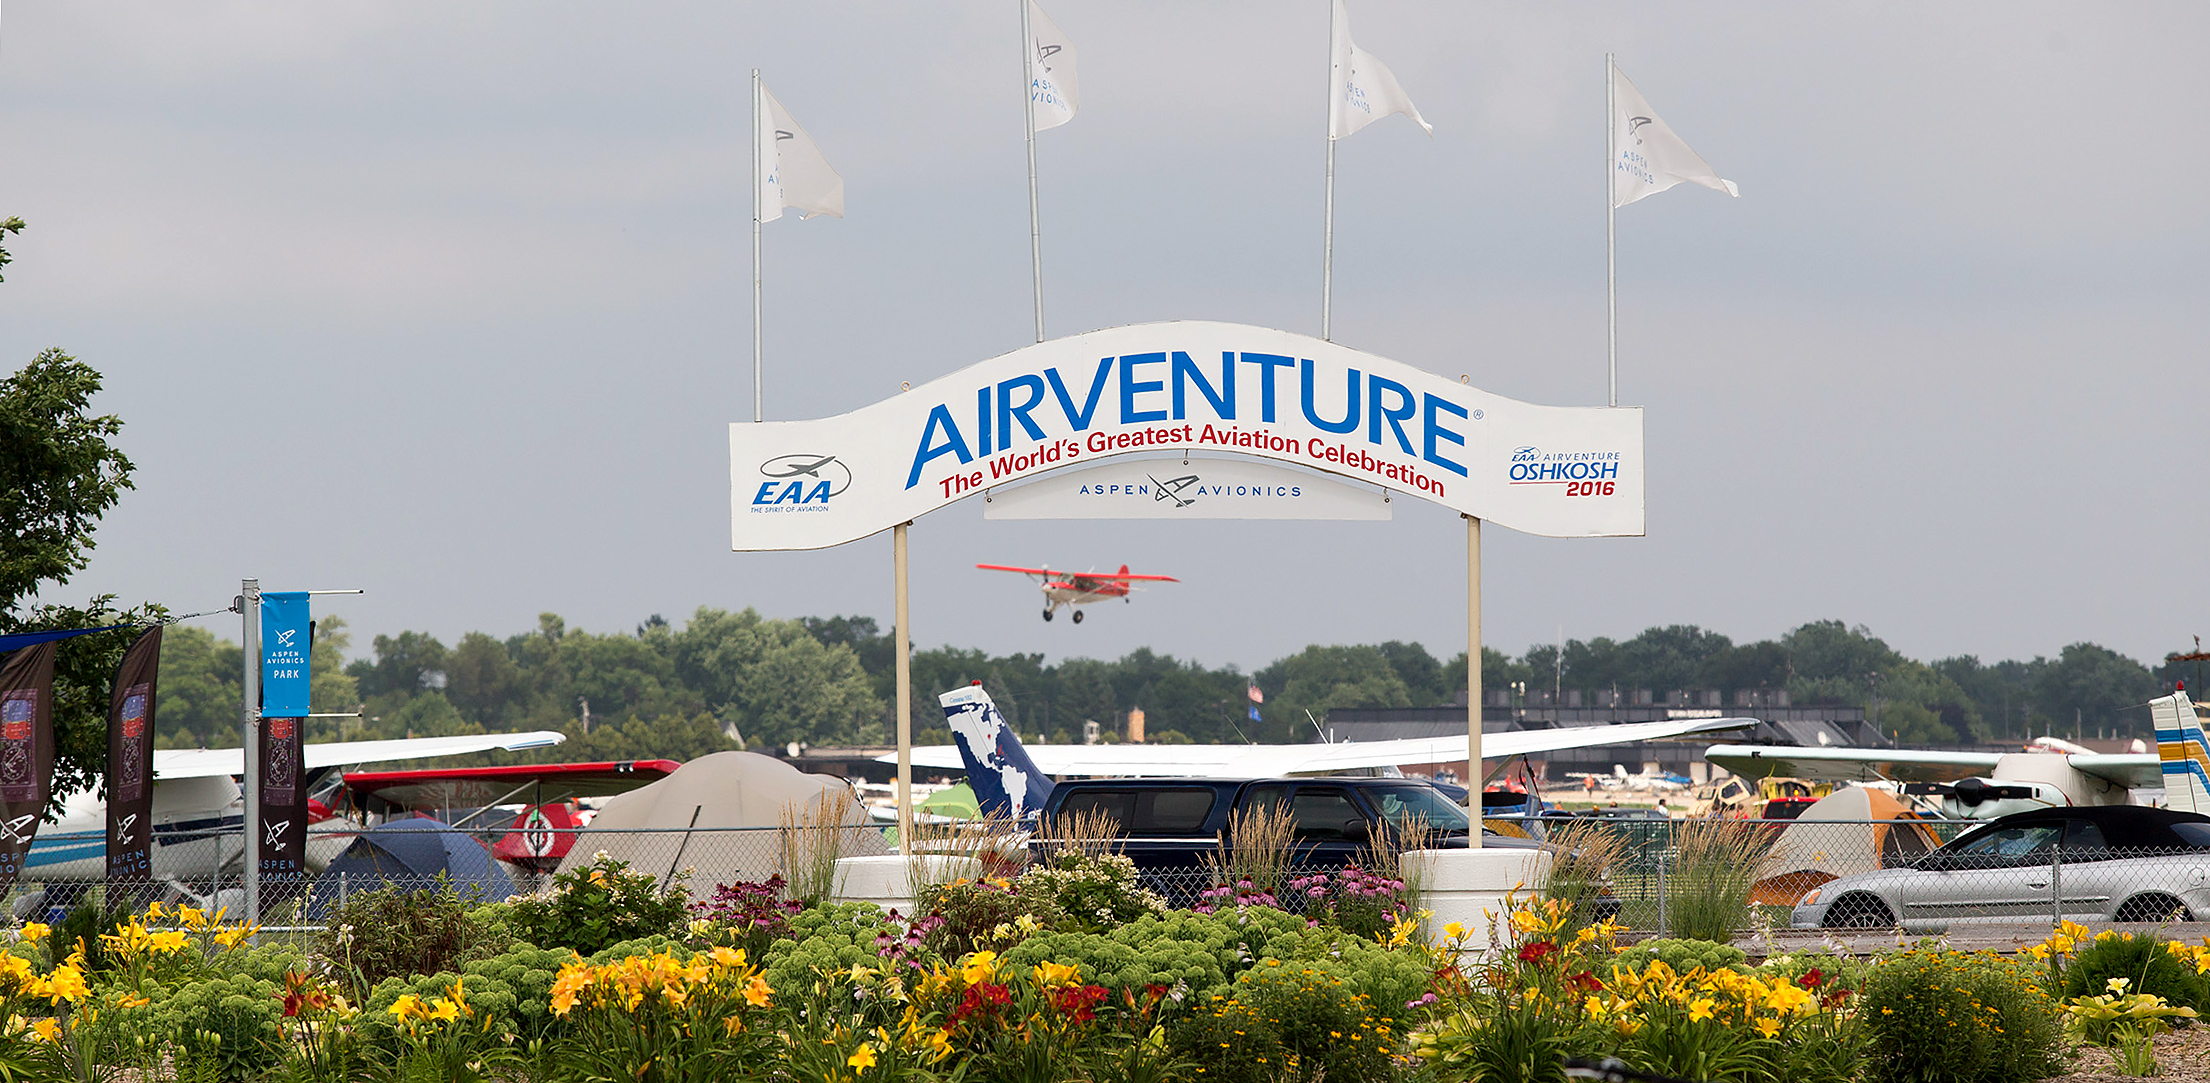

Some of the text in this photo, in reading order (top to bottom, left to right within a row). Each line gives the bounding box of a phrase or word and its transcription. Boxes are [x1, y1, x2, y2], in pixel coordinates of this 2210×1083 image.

[905, 351, 1468, 491] AIRVENTURE
[938, 424, 1445, 499] The World's Greatest Aviation Celebration
[1511, 451, 1621, 462] EAA AIRVENTURE
[1509, 461, 1619, 481] OSHKOSH
[752, 480, 832, 505] EAA
[1079, 484, 1302, 497] ASPEN AVIONICS
[1566, 480, 1616, 497] 2016
[750, 506, 763, 514] THE
[764, 506, 784, 514] SPIRIT
[796, 505, 829, 513] AVIATION
[272, 650, 299, 658] ASPEN
[267, 657, 305, 665] AVIONICS
[273, 669, 299, 679] PARK
